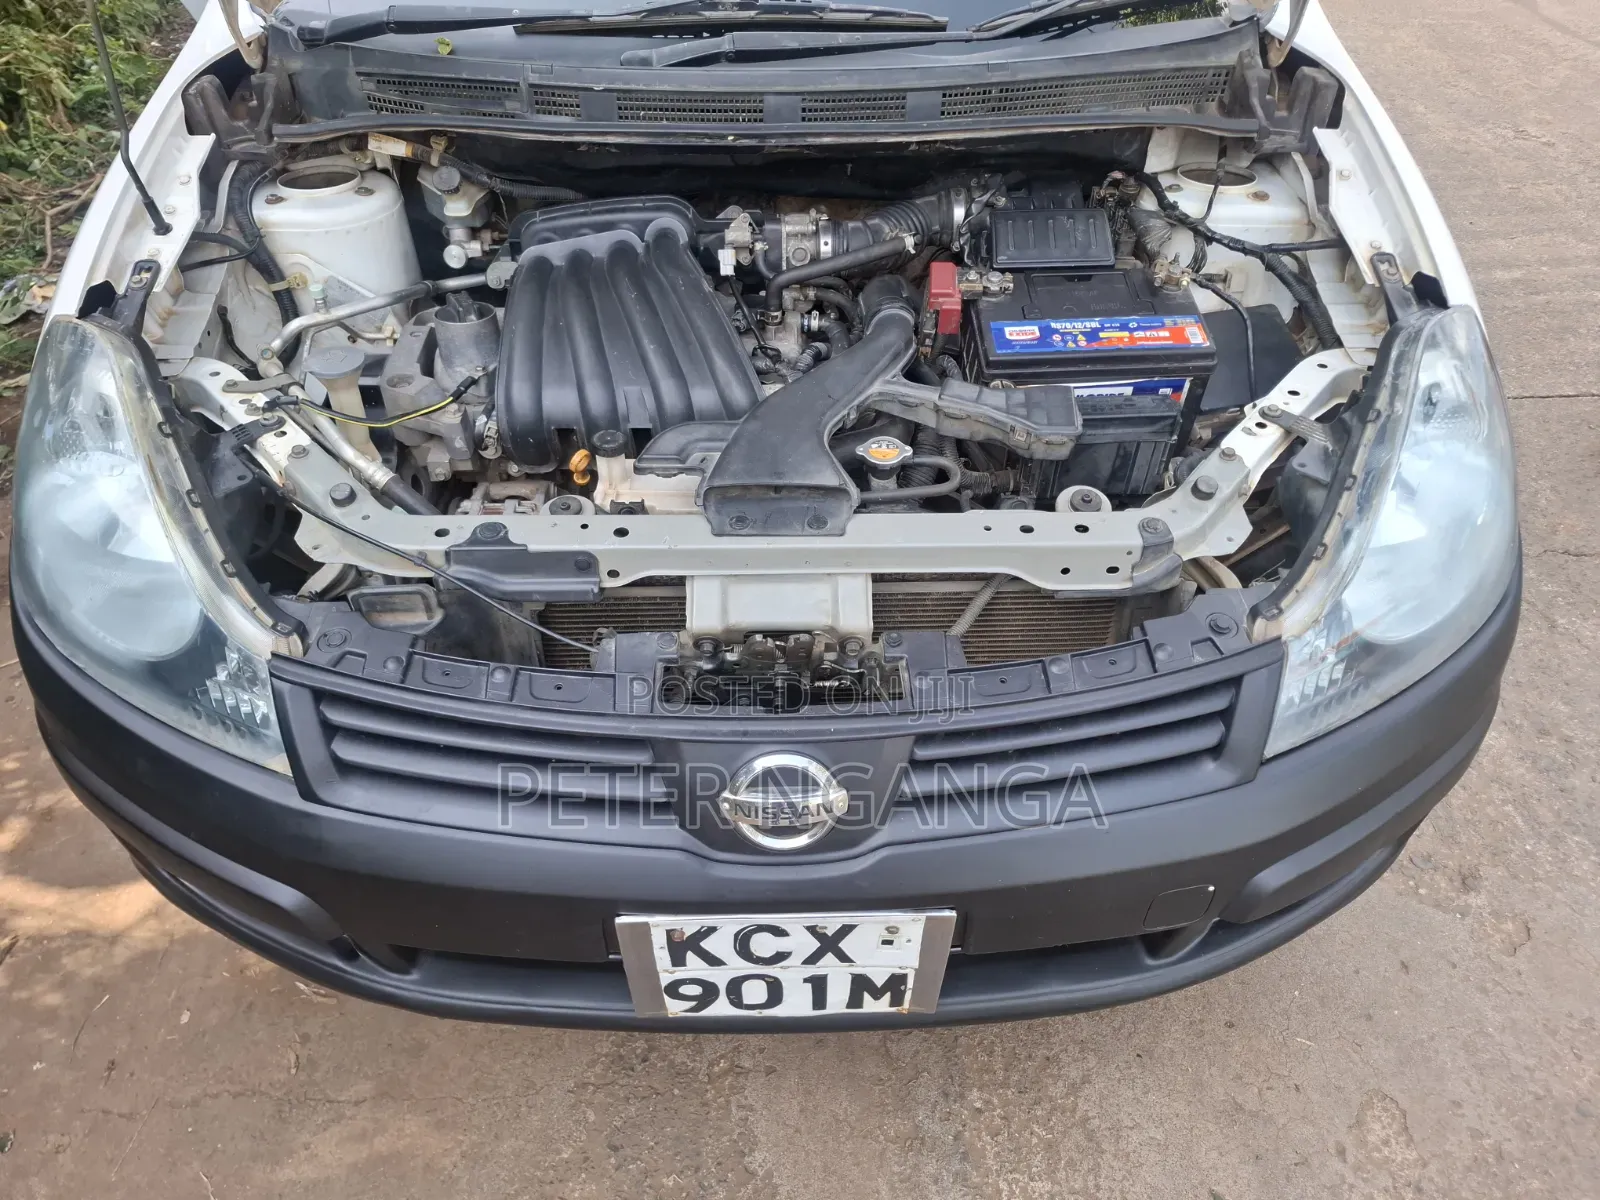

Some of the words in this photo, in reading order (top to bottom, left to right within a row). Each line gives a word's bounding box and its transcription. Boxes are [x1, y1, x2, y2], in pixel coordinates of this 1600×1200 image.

[734, 803, 833, 820] NISSAN
[665, 923, 859, 968] KCX
[663, 973, 909, 1013] 901M
